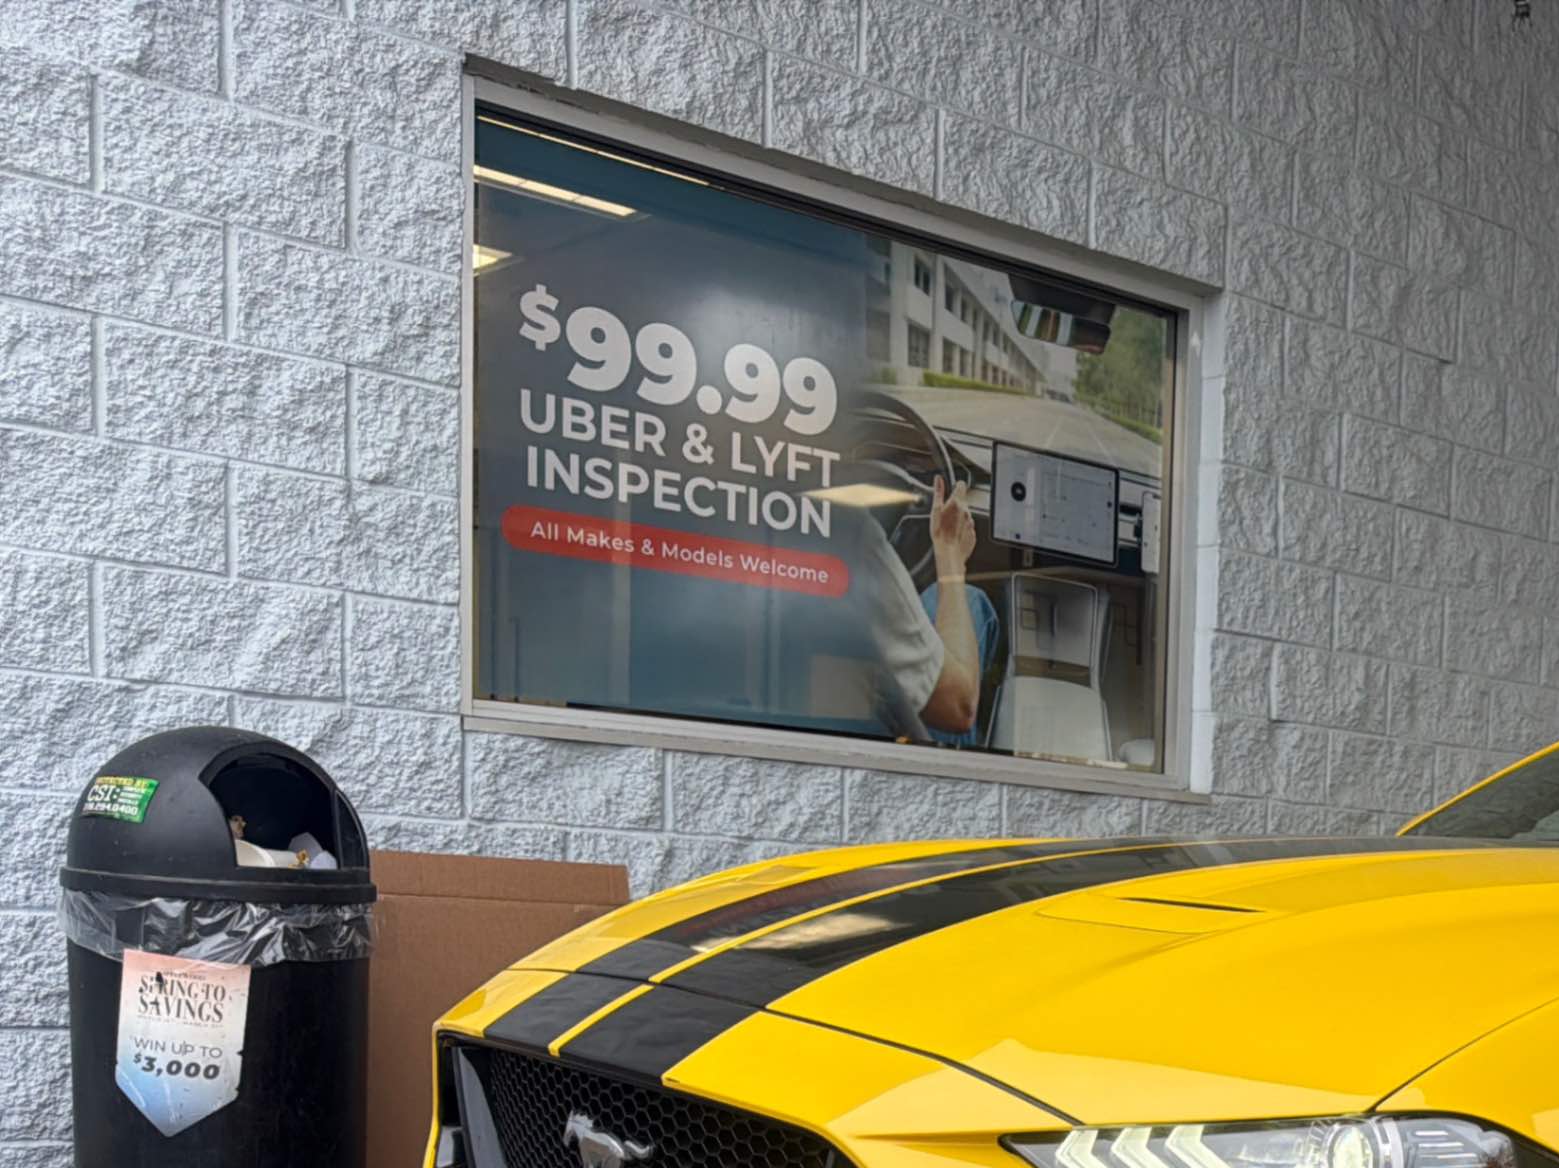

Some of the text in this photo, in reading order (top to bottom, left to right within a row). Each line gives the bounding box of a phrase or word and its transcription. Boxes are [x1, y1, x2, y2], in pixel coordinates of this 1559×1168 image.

[519, 284, 838, 435] $99.99
[520, 389, 840, 488] UBER & LYFT
[526, 446, 831, 538] INSPECTION
[531, 521, 829, 584] All Makes & Models Welcome
[138, 995, 224, 1023] SAVINGS
[133, 1053, 221, 1079] $3,000
[134, 1037, 222, 1058] WIN UP TO
